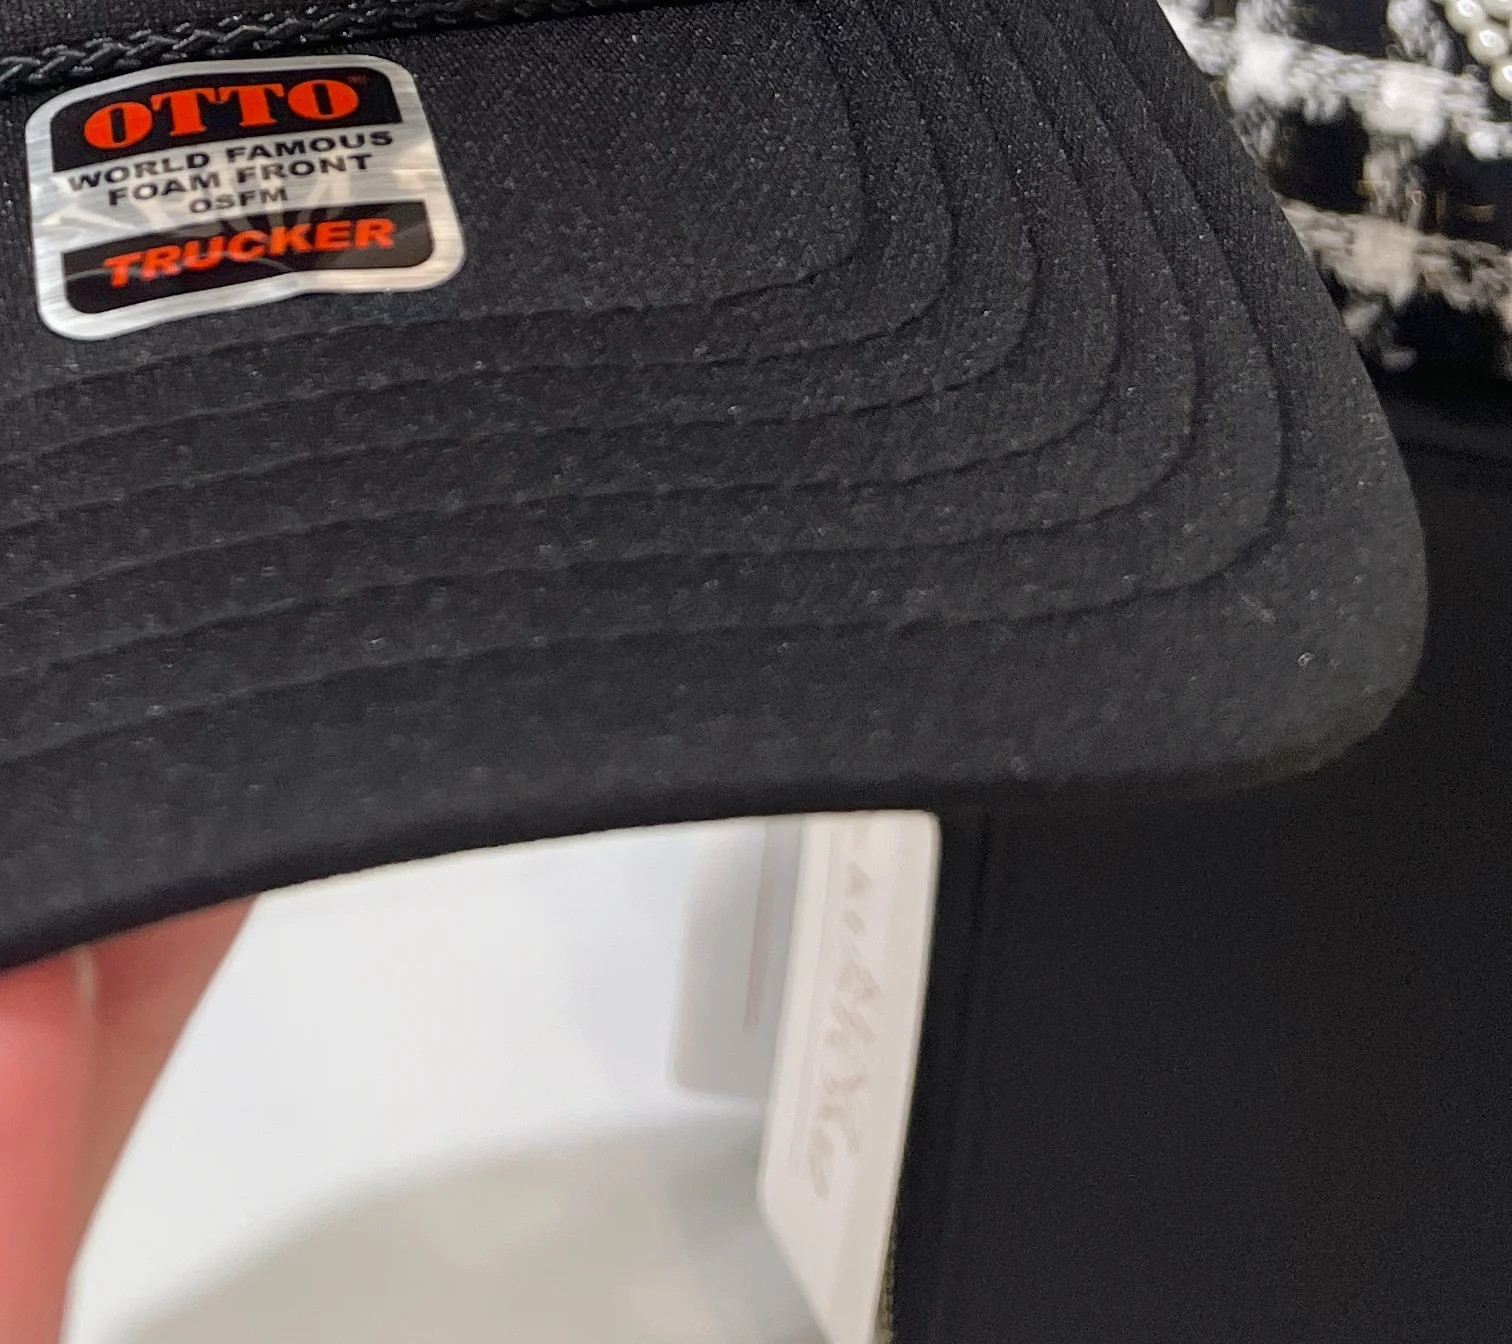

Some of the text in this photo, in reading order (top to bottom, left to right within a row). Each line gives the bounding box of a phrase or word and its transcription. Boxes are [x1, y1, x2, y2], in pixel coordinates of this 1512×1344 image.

[83, 78, 360, 150] OTTO
[67, 130, 394, 194] WORLD FAMOUS
[107, 153, 374, 207] FOAM FRONT
[189, 187, 289, 215] OSFM
[103, 217, 396, 289] TRUCKER
